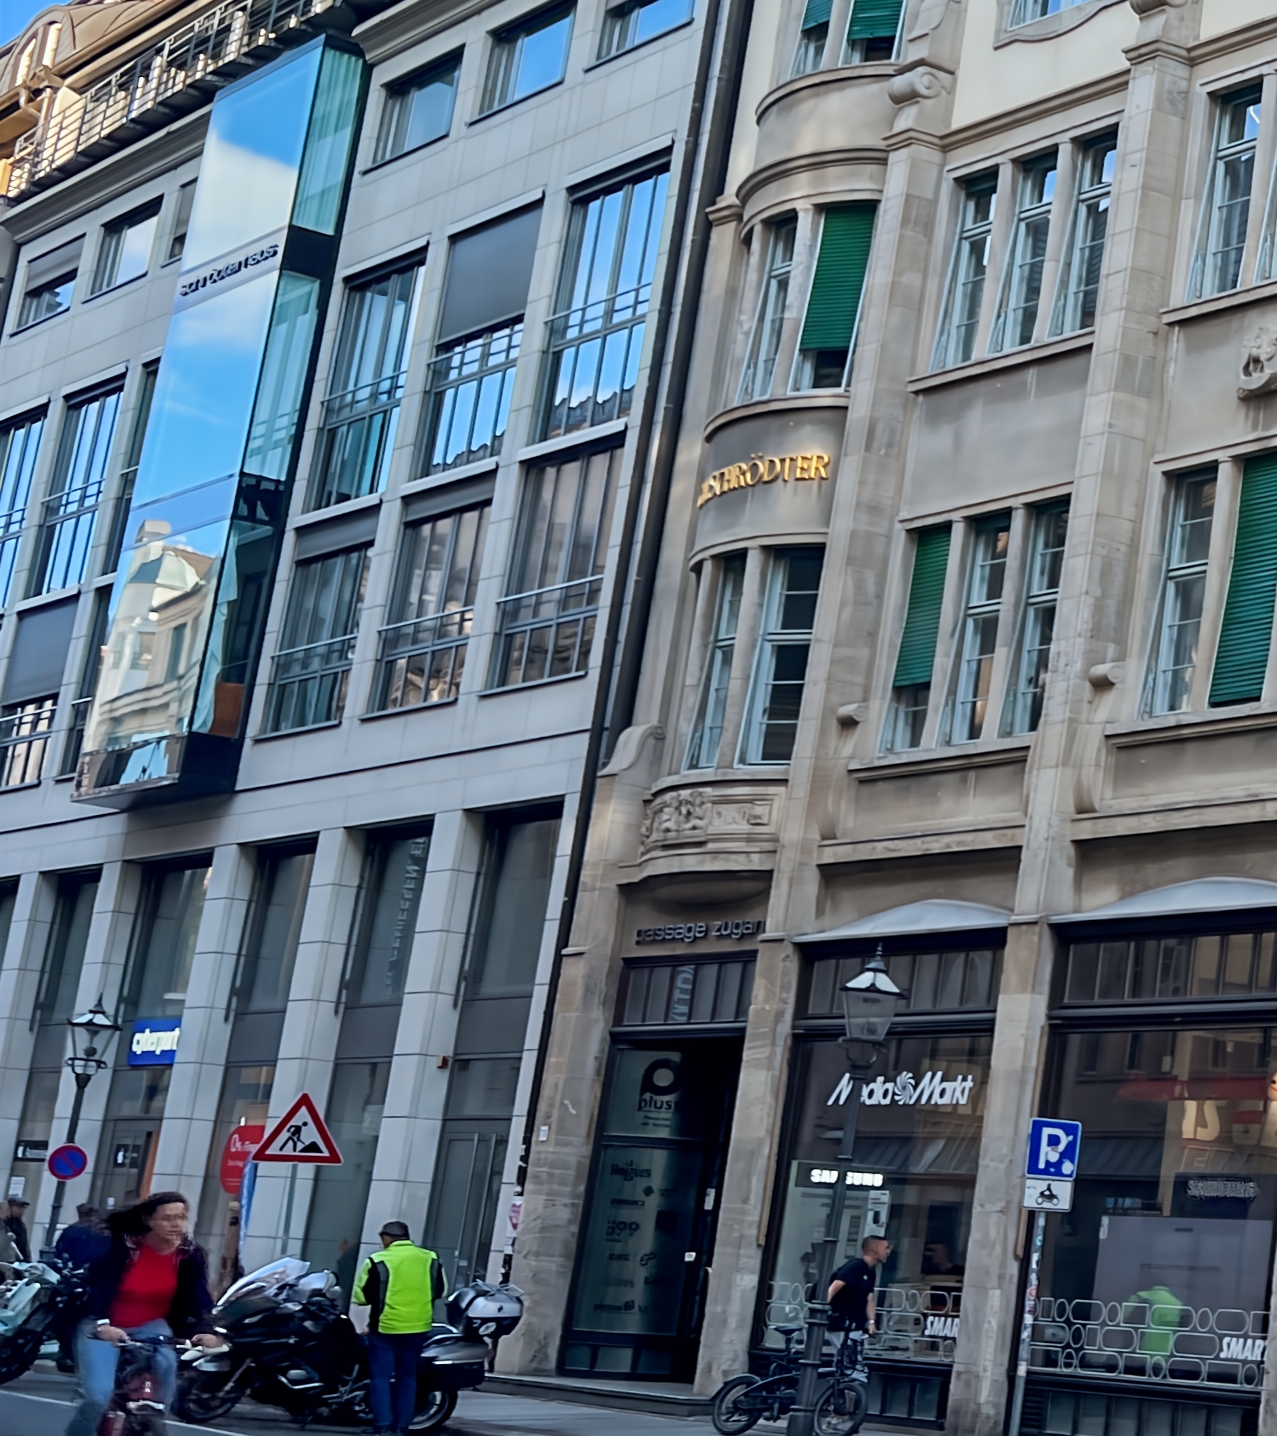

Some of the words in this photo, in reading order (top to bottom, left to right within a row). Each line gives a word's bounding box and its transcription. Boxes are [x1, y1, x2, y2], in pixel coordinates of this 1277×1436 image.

[635, 922, 707, 945] passage
[711, 920, 766, 939] zugan
[910, 1071, 974, 1105] Markt
[924, 1316, 960, 1338] SMAR
[1220, 1336, 1266, 1361] SMAR
